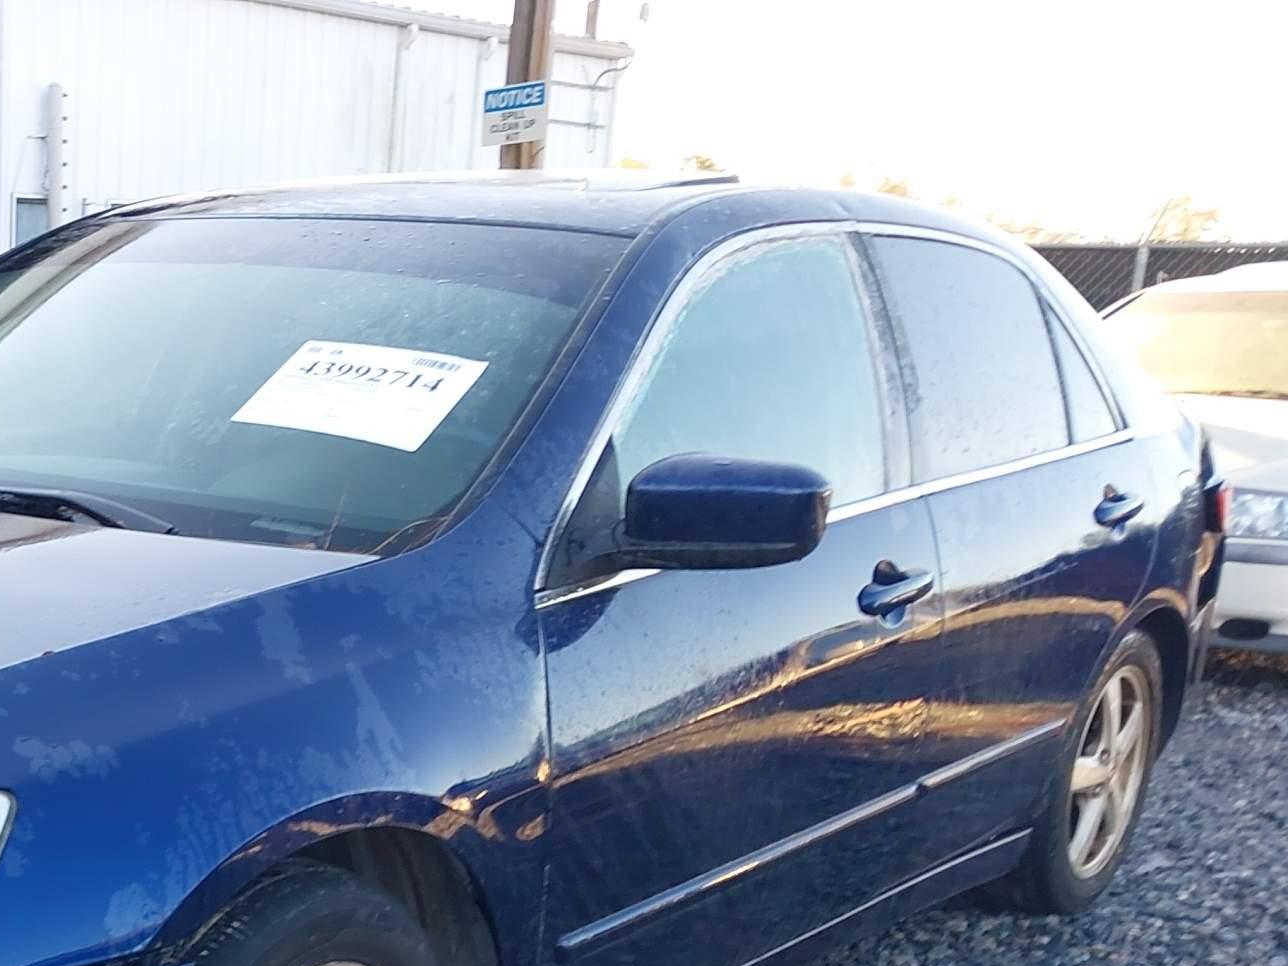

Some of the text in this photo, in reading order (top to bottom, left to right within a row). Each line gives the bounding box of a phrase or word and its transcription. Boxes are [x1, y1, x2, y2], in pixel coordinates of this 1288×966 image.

[487, 86, 543, 109] NOTICE
[490, 122, 520, 133] CLEAN
[299, 361, 445, 392] 43992714
